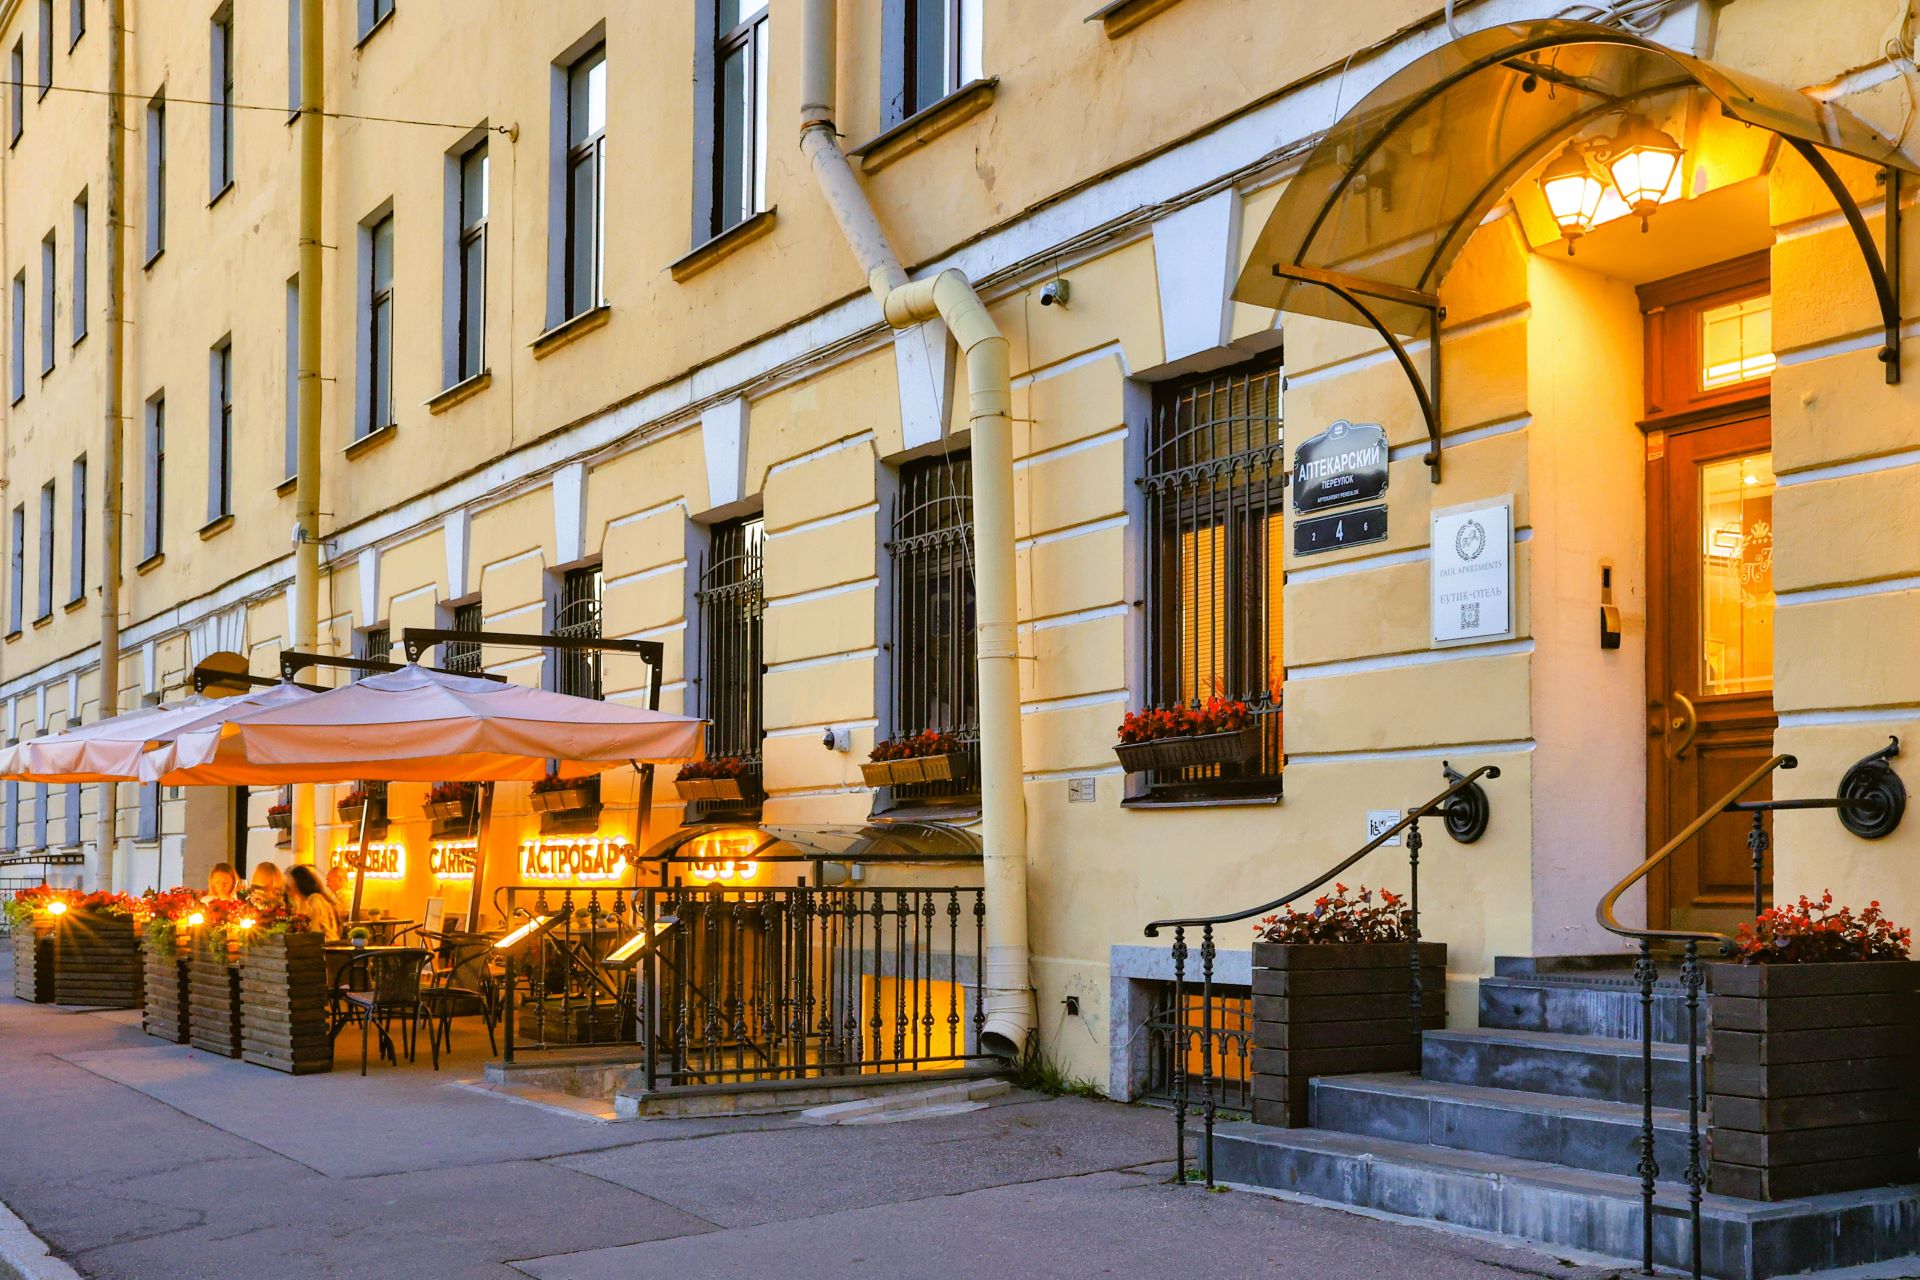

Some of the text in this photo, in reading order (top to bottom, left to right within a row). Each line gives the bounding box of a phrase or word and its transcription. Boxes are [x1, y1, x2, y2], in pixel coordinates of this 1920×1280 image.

[1298, 443, 1379, 482] АПТЕКАРСКИЙ
[1321, 475, 1354, 490] ПЕРЕУЛОК
[1311, 520, 1368, 541] 2 4 6
[1440, 560, 1502, 577] PAUL APARTMENTS
[1440, 587, 1502, 605] БУТИК-ОТЕЛЬ
[331, 849, 398, 872] GASOBAR
[518, 844, 620, 874] ГАСТРОБАР
